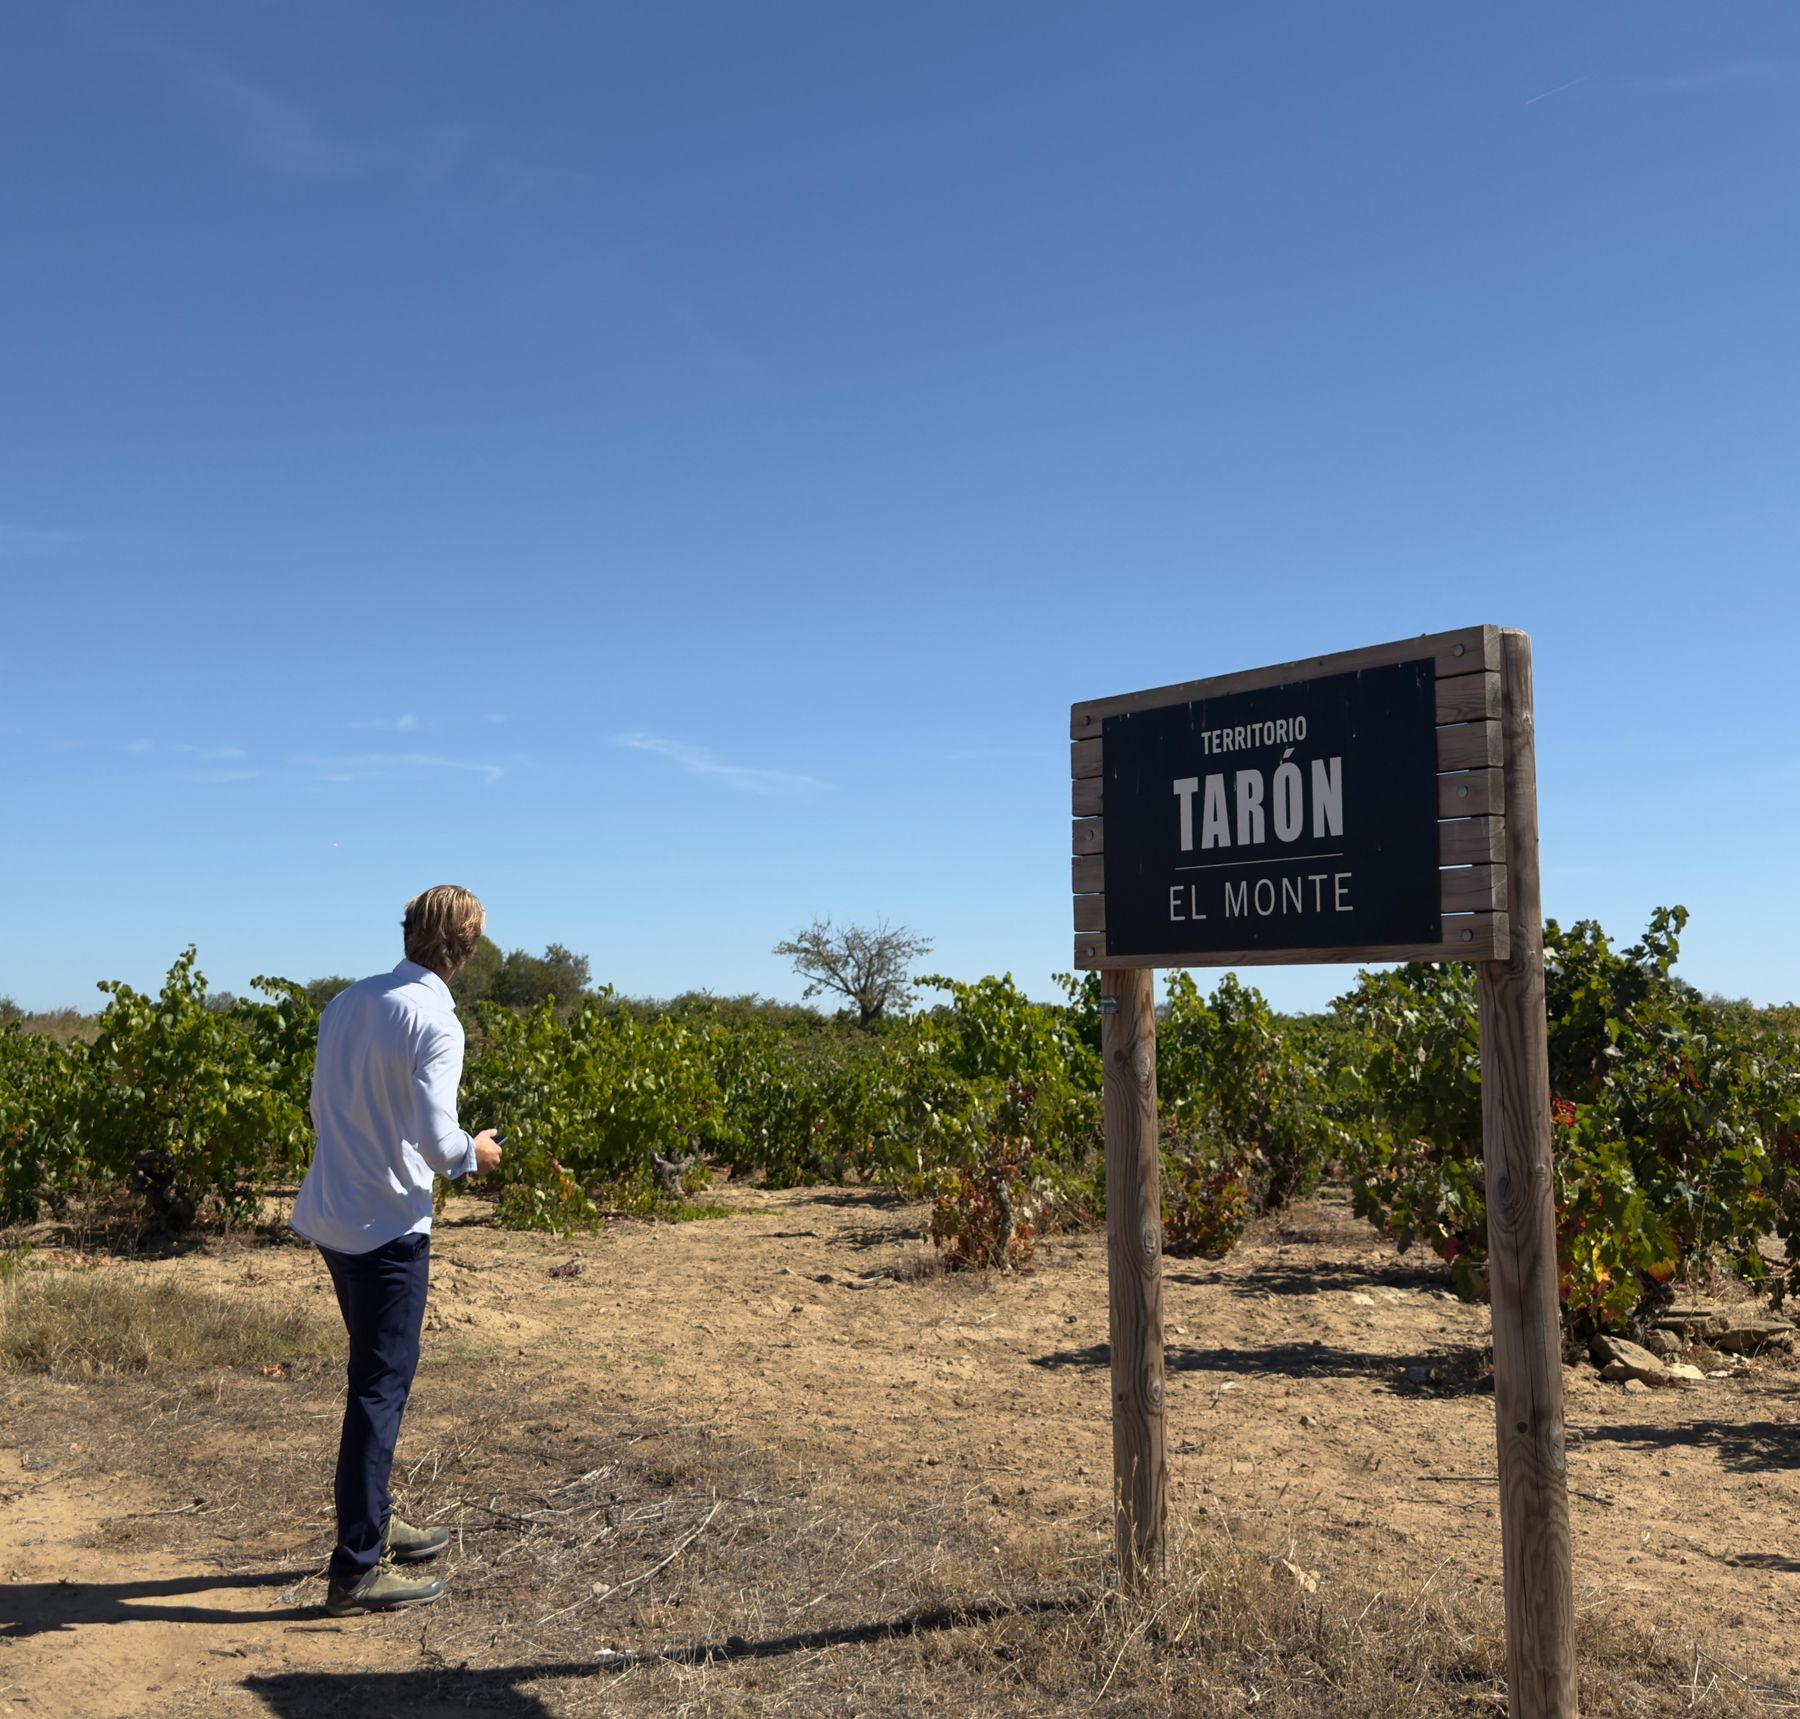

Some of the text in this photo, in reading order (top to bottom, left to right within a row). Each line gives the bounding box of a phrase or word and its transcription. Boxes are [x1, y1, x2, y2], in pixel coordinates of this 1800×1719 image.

[1201, 715, 1307, 755] TERRITORIO
[1173, 748, 1343, 851] TARÓN
[1169, 872, 1354, 921] EL MONTE
